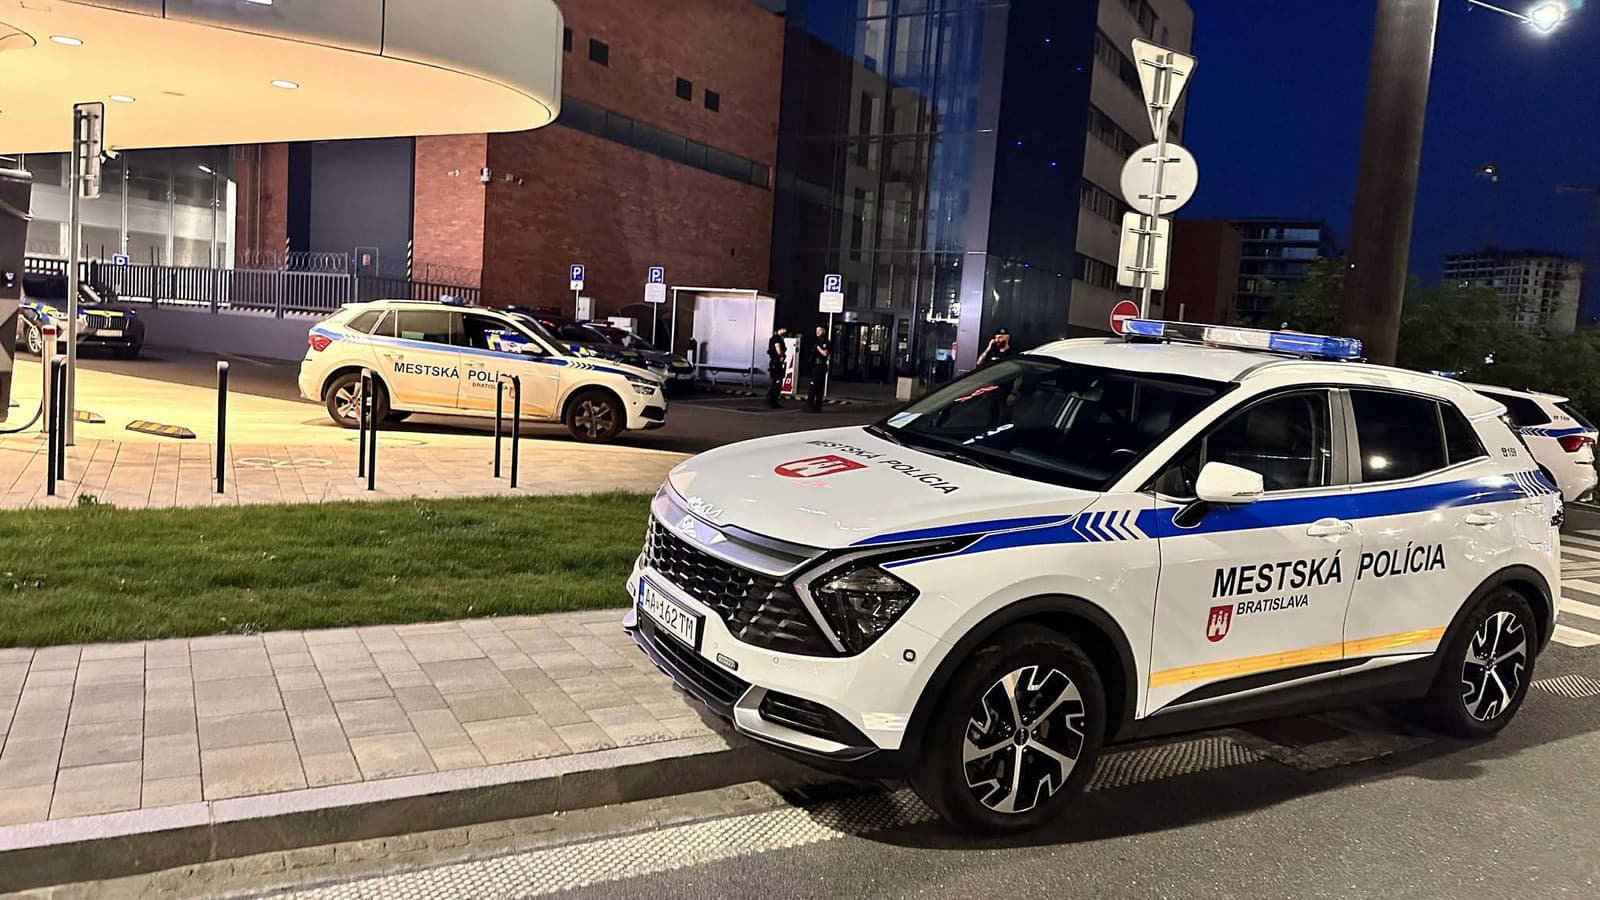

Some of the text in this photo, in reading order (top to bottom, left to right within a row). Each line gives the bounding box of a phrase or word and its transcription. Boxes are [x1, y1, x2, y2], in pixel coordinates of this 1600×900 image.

[572, 266, 582, 280] P
[651, 269, 661, 282] P
[827, 277, 838, 291] P
[394, 361, 460, 379] MESTSKÁ
[879, 459, 960, 494] POLÍCIA
[1212, 541, 1446, 598] MESTSKÁ POLÍCIA
[1236, 594, 1309, 616] BRATISLAVA
